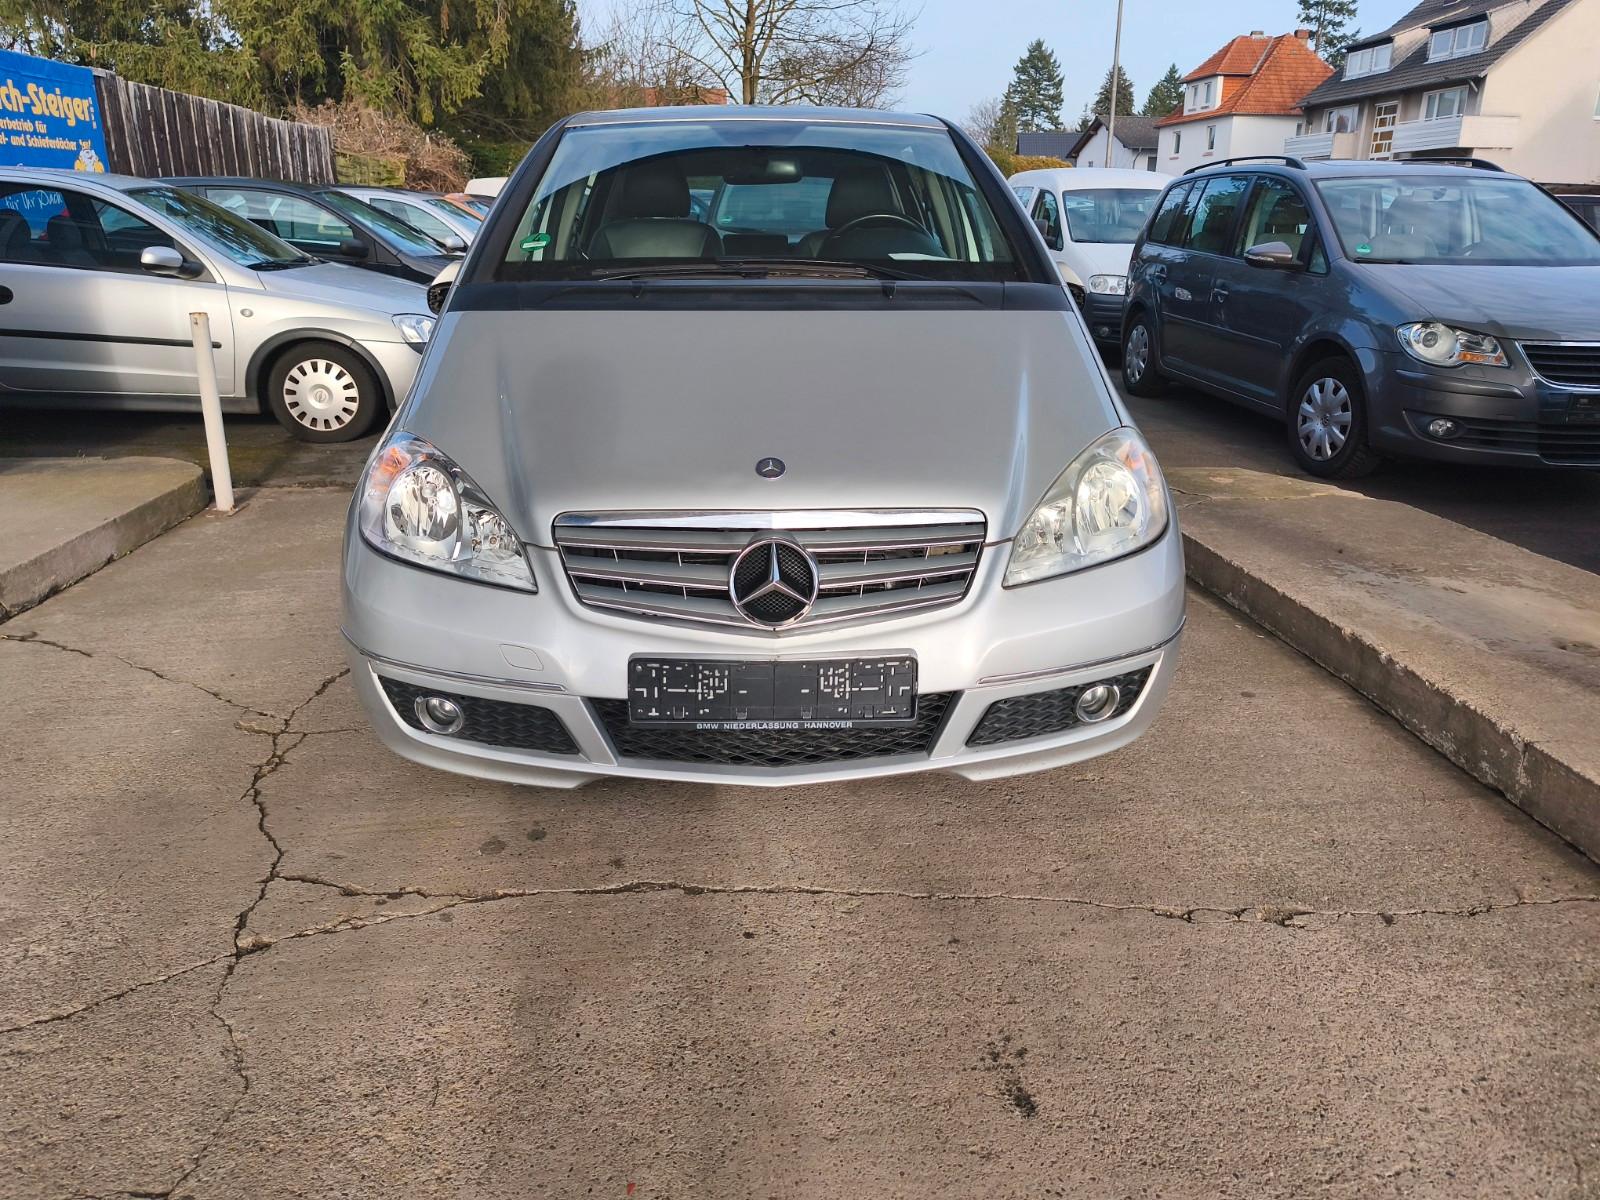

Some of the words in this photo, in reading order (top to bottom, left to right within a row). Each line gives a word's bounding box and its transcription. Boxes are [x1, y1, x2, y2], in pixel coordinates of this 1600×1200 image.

[0, 79, 90, 127] ch-Steiger
[35, 120, 47, 134] für
[10, 134, 26, 147] und
[696, 722, 719, 730] BMW
[723, 722, 799, 730] NIEDERLASSUNG
[804, 721, 853, 729] HANNOVER
